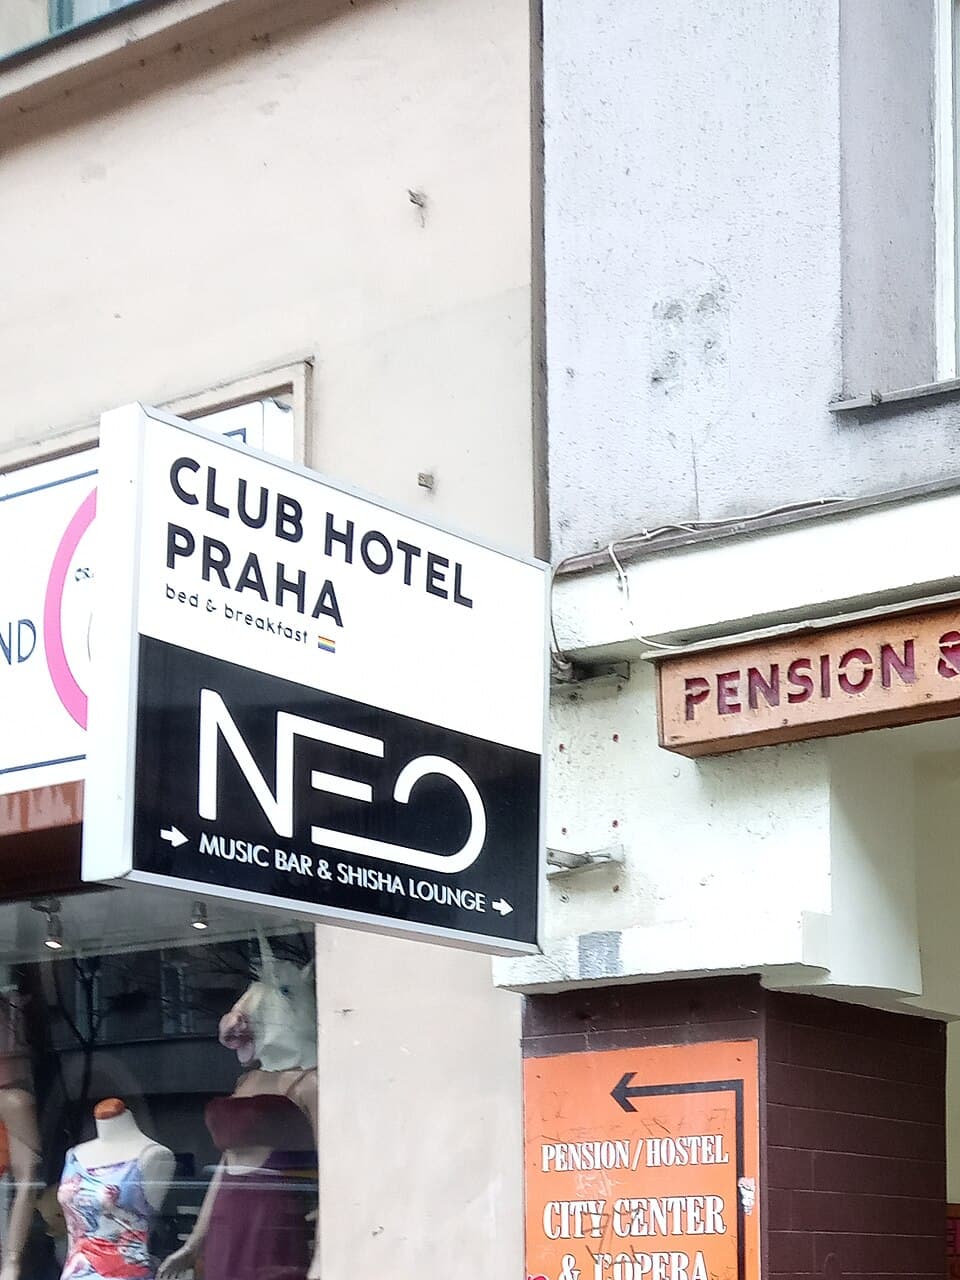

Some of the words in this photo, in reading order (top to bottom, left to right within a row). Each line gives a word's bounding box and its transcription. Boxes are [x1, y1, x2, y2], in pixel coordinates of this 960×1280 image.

[170, 457, 303, 543] CLUB
[325, 513, 474, 609] HOTEL
[166, 584, 199, 608] bed
[205, 599, 217, 613] &
[225, 603, 308, 643] breakfast
[167, 522, 344, 628] PRAHA
[685, 638, 916, 721] PENSION
[199, 688, 487, 874] NEO
[199, 832, 269, 867] MUSIC
[275, 849, 312, 877] BAR
[317, 860, 332, 880] &
[337, 864, 405, 897] SHISHA
[409, 878, 486, 913] LOUNGE
[543, 1200, 606, 1240] CITY
[613, 1195, 727, 1237] CENTER
